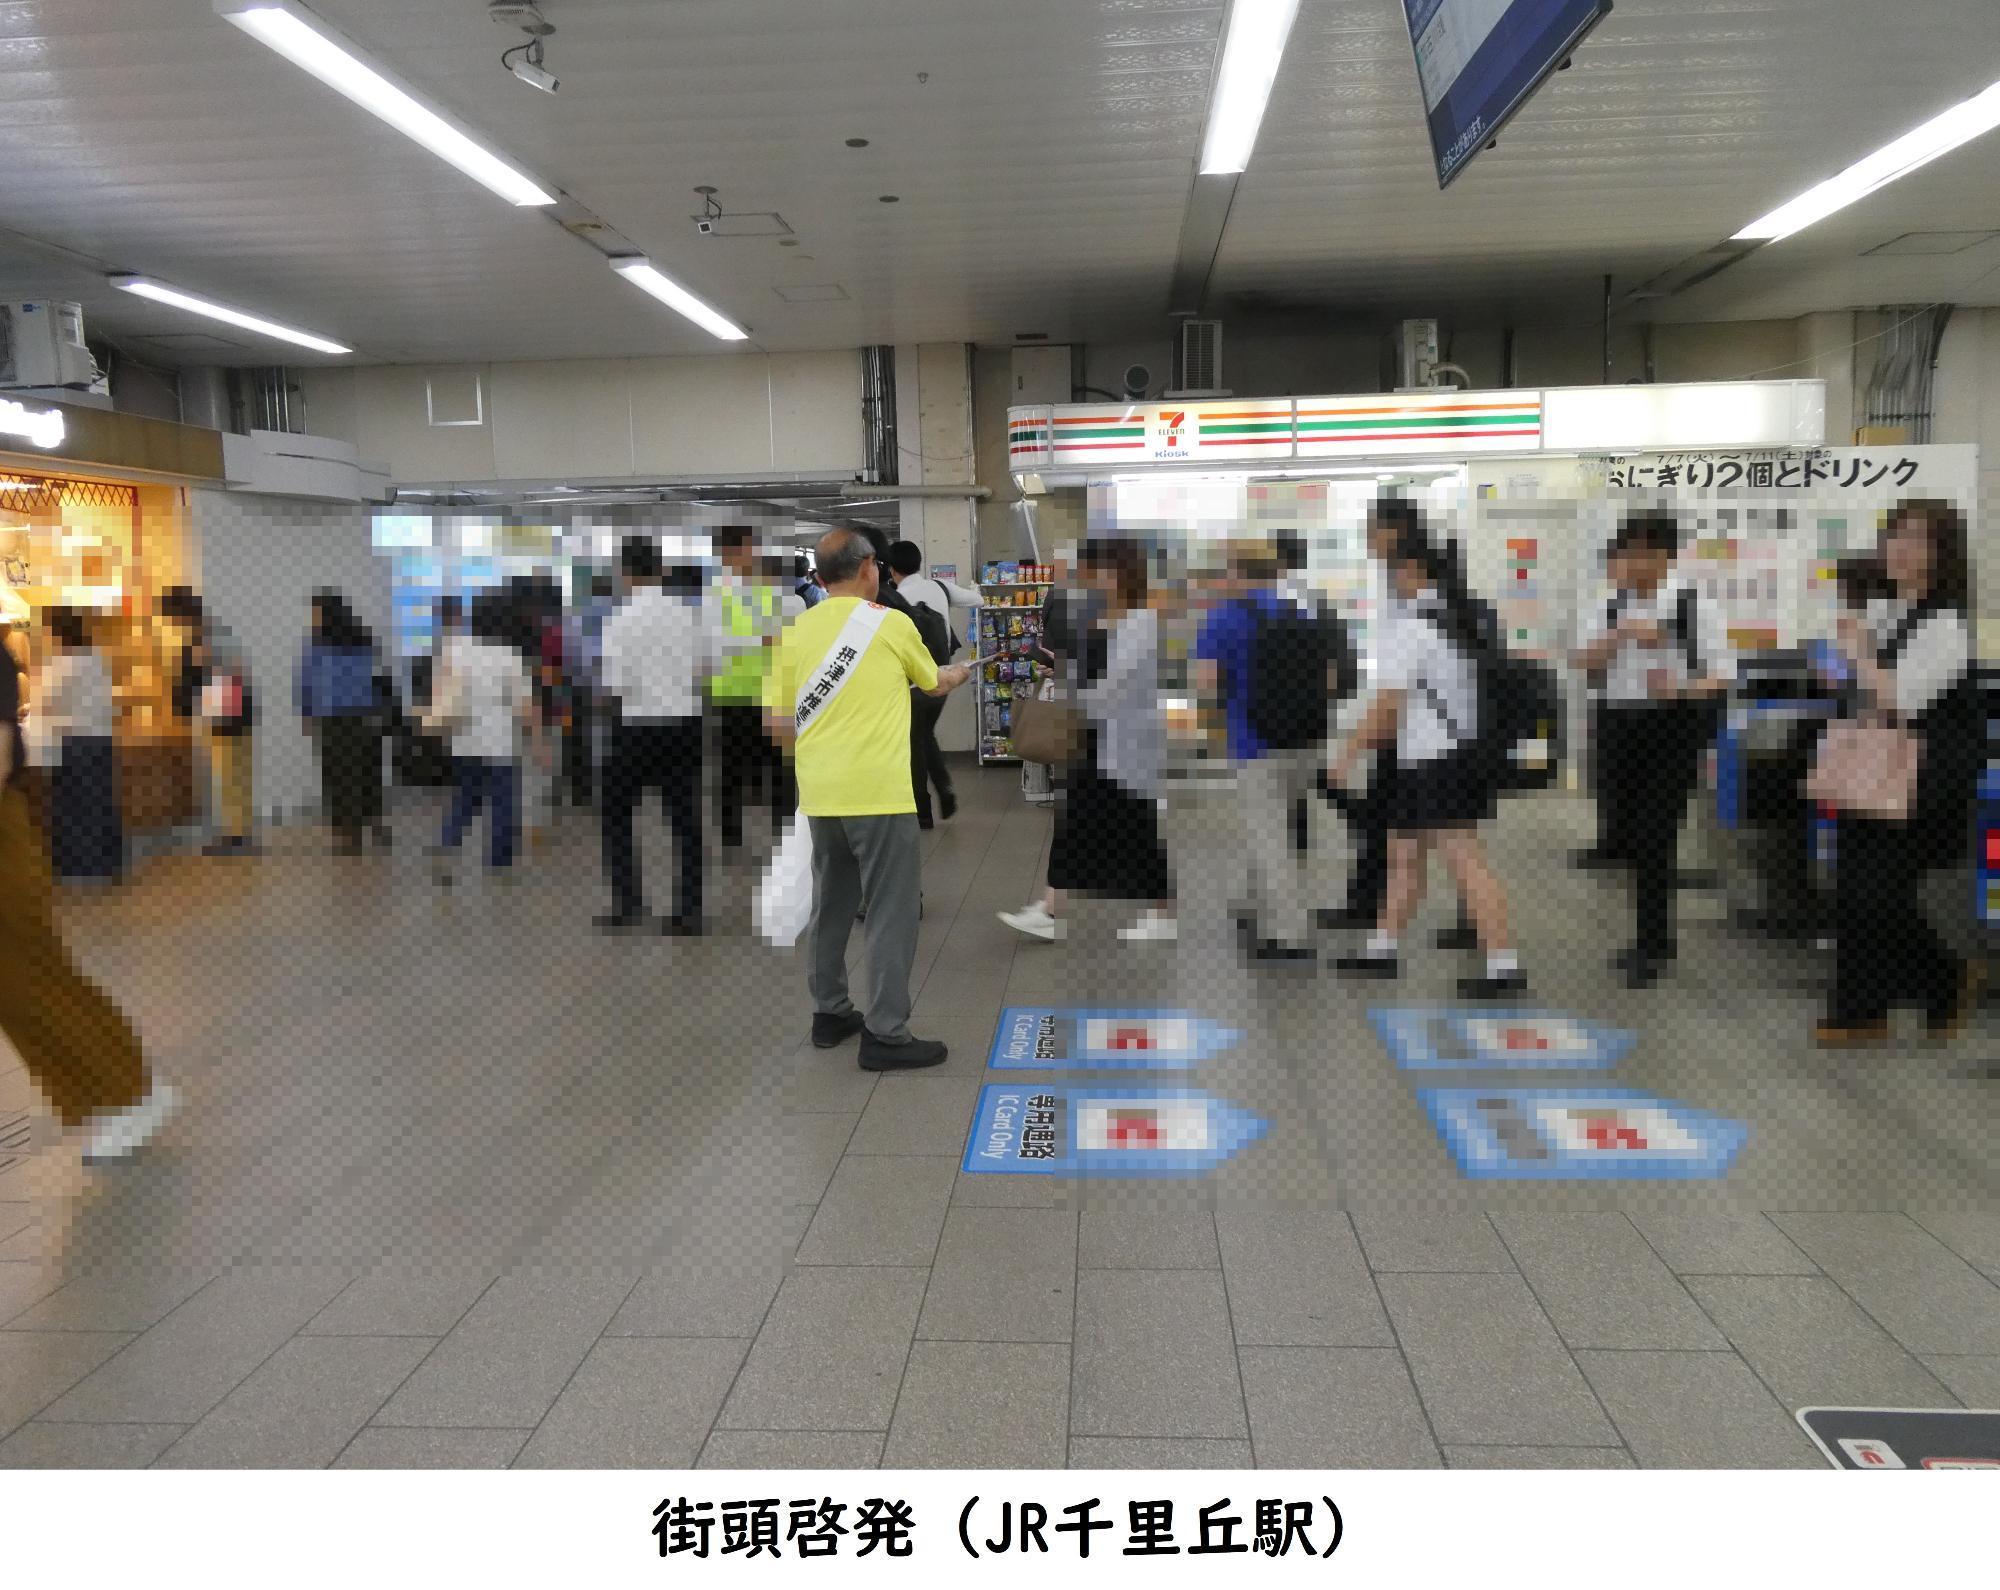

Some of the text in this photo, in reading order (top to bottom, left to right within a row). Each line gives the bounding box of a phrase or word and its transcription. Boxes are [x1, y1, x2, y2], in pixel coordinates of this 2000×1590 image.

[1159, 411, 1184, 447] 7
[1011, 1026, 1033, 1040] Card
[1002, 1040, 1030, 1060] Only
[980, 1094, 1020, 1159] IC Card Only
